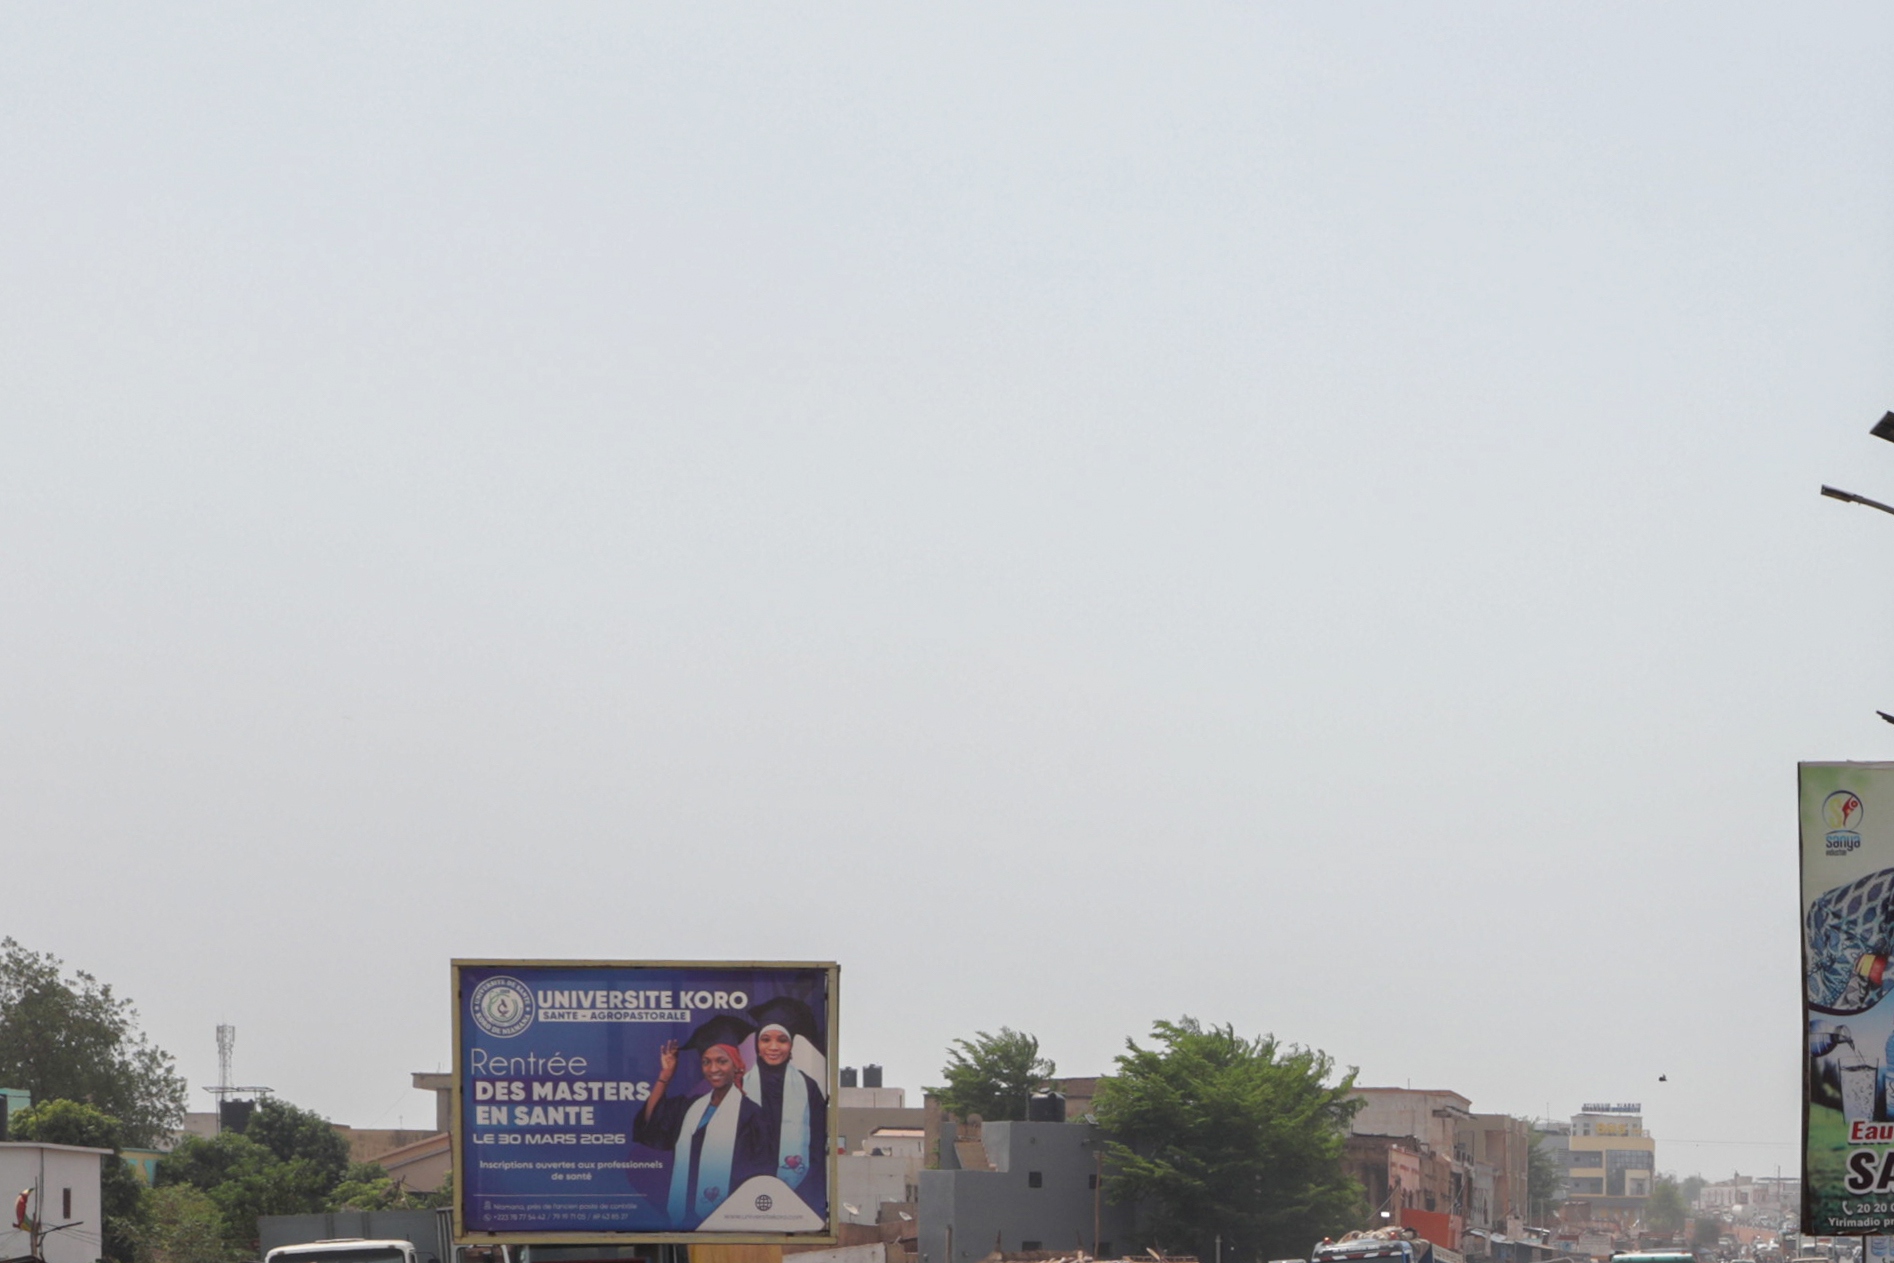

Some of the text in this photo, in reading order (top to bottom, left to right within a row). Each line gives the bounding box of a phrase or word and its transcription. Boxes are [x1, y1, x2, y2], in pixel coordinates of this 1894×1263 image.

[1825, 835, 1861, 852] sanya
[537, 990, 748, 1010] UNIVERSITE KORO
[542, 1011, 579, 1021] SANTE
[590, 1010, 686, 1021] AGROPASTORALE
[471, 1048, 588, 1076] Rentrée
[475, 1081, 651, 1101] DES MASTERS
[476, 1106, 595, 1126] EN SANTE
[1850, 1120, 1894, 1141] Eau
[473, 1133, 626, 1145] LE 30 MARS 2026
[479, 1160, 534, 1170] Inscriptions
[535, 1161, 576, 1169] ouvertes
[597, 1160, 663, 1170] professionnels
[551, 1171, 593, 1181] de santé
[1856, 1203, 1871, 1214] 20
[1873, 1203, 1887, 1213] 20
[1828, 1217, 1881, 1227] Yirimadio
